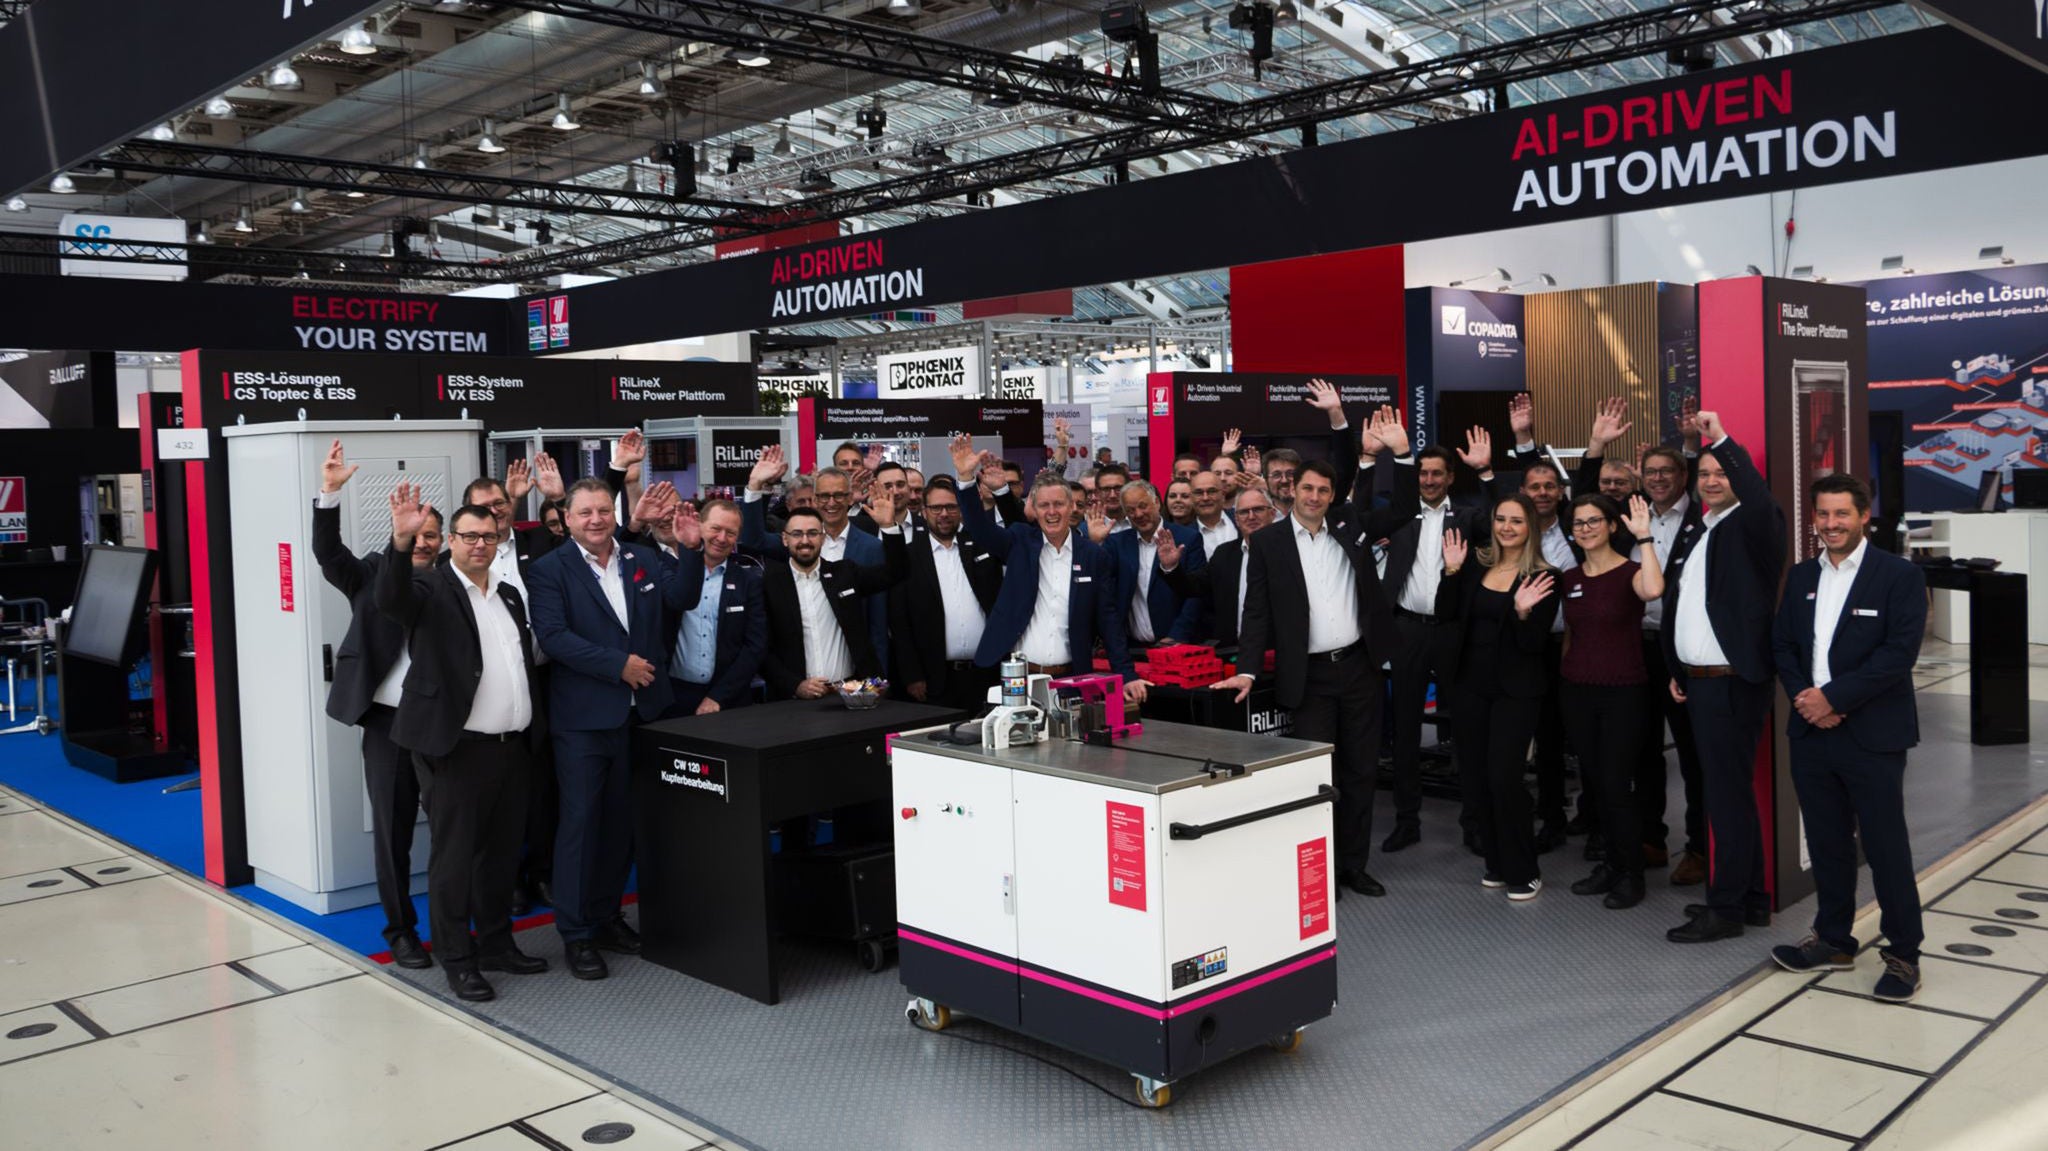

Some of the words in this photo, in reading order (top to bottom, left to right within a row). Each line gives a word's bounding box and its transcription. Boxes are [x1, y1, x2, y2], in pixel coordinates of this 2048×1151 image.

[1511, 69, 1792, 161] AI-DRIVEN
[1512, 110, 1896, 212] AUTOMATION
[771, 239, 884, 285] AI-DRIVEN
[772, 268, 923, 318] AUTOMATION
[293, 296, 438, 323] ELECTRIFY
[1866, 300, 1886, 314] e,
[1890, 289, 1984, 311] zahlreiche
[1782, 303, 1808, 319] RiLineX
[1890, 314, 1928, 325] Schaffung
[1929, 313, 1949, 322] einer
[1950, 309, 1985, 321] digitalen
[1986, 308, 2002, 317] und
[2003, 305, 2032, 317] grünen
[1468, 321, 1517, 339] COPADATA
[1782, 321, 1796, 336] The
[1797, 322, 1818, 337] Power
[295, 326, 376, 350] YOUR
[385, 329, 487, 352] SYSTEM
[49, 364, 85, 385] BALLUFF
[234, 372, 341, 387] ESS-Lösungen
[448, 375, 524, 389] ESS-System
[620, 377, 661, 388] RiLineX
[908, 372, 965, 389] CONTACT
[234, 387, 256, 400] CS
[260, 387, 309, 402] Toptec
[313, 387, 324, 400] &
[327, 387, 356, 400] ESS
[448, 389, 466, 401] VX
[469, 389, 495, 401] ESS
[620, 390, 640, 400] The
[643, 391, 675, 401] Power
[678, 391, 725, 401] Plattform
[1003, 388, 1035, 400] NTACT
[1197, 384, 1215, 392] Driven
[1216, 385, 1242, 393] Industrial
[1188, 394, 1221, 402] Automation
[175, 441, 194, 450] 432
[715, 445, 763, 461] RiLine
[0, 517, 26, 528] LAN
[674, 758, 687, 771] CW
[688, 762, 700, 774] 120
[702, 763, 709, 775] M
[661, 771, 724, 795] Kupferbearbeitung
